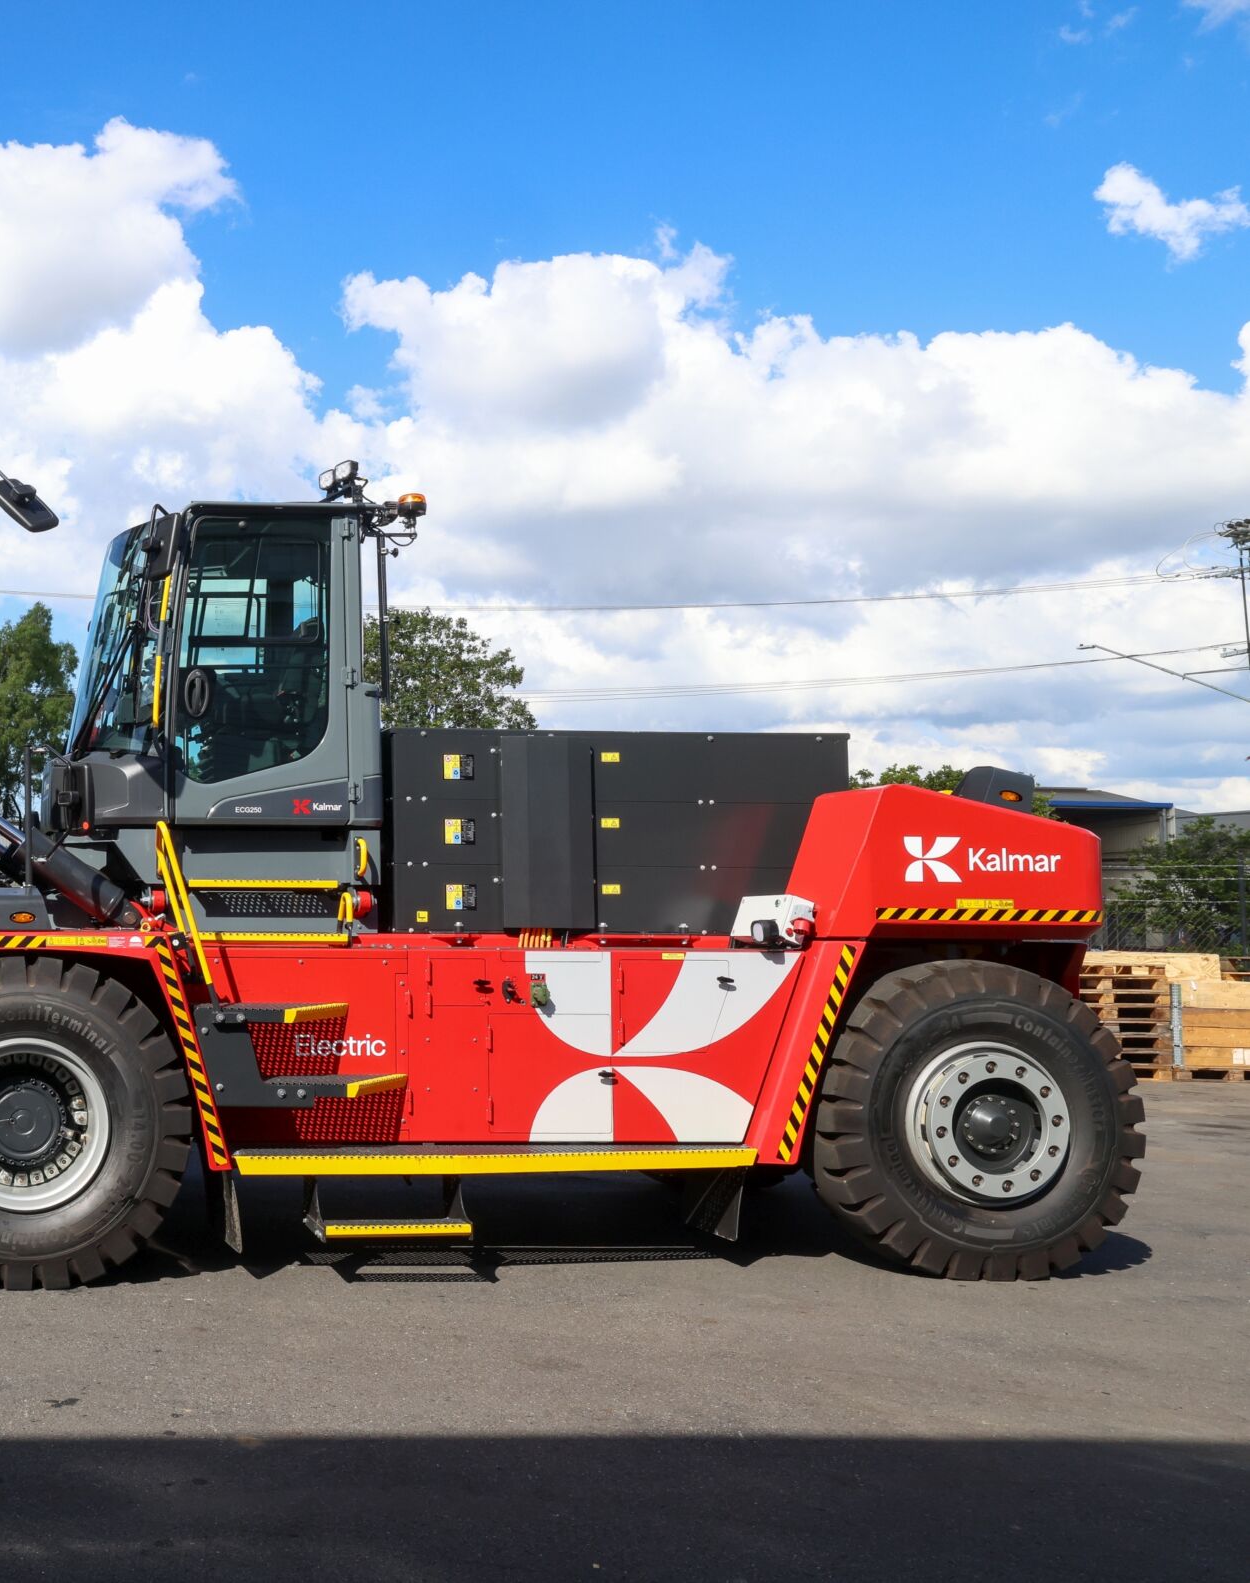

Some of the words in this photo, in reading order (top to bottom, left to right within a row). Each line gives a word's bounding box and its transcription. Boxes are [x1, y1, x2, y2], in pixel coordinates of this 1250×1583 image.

[235, 806, 262, 814] ECG250
[312, 802, 342, 811] Kalmar
[968, 847, 1061, 872] Kalmar
[295, 1033, 387, 1057] Electric
